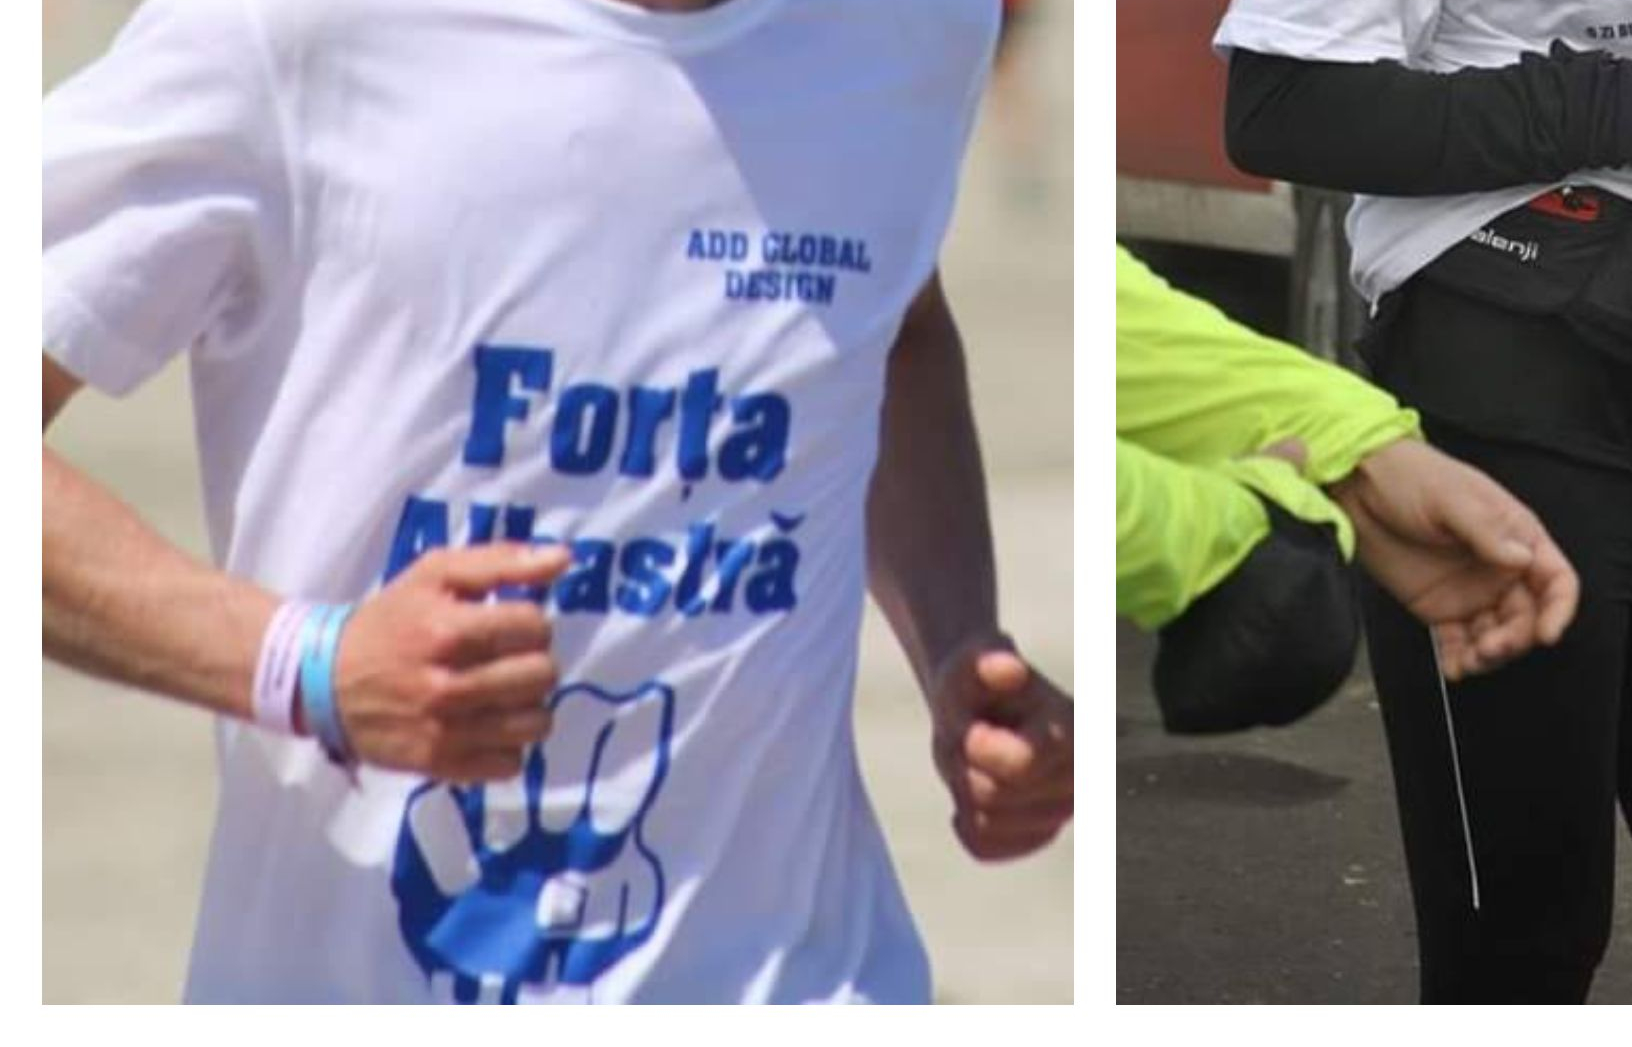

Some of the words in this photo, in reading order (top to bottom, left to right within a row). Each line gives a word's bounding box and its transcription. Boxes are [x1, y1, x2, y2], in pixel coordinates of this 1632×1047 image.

[688, 228, 749, 261] ADD
[1469, 227, 1540, 262] alenji
[724, 269, 836, 305] DESIGN
